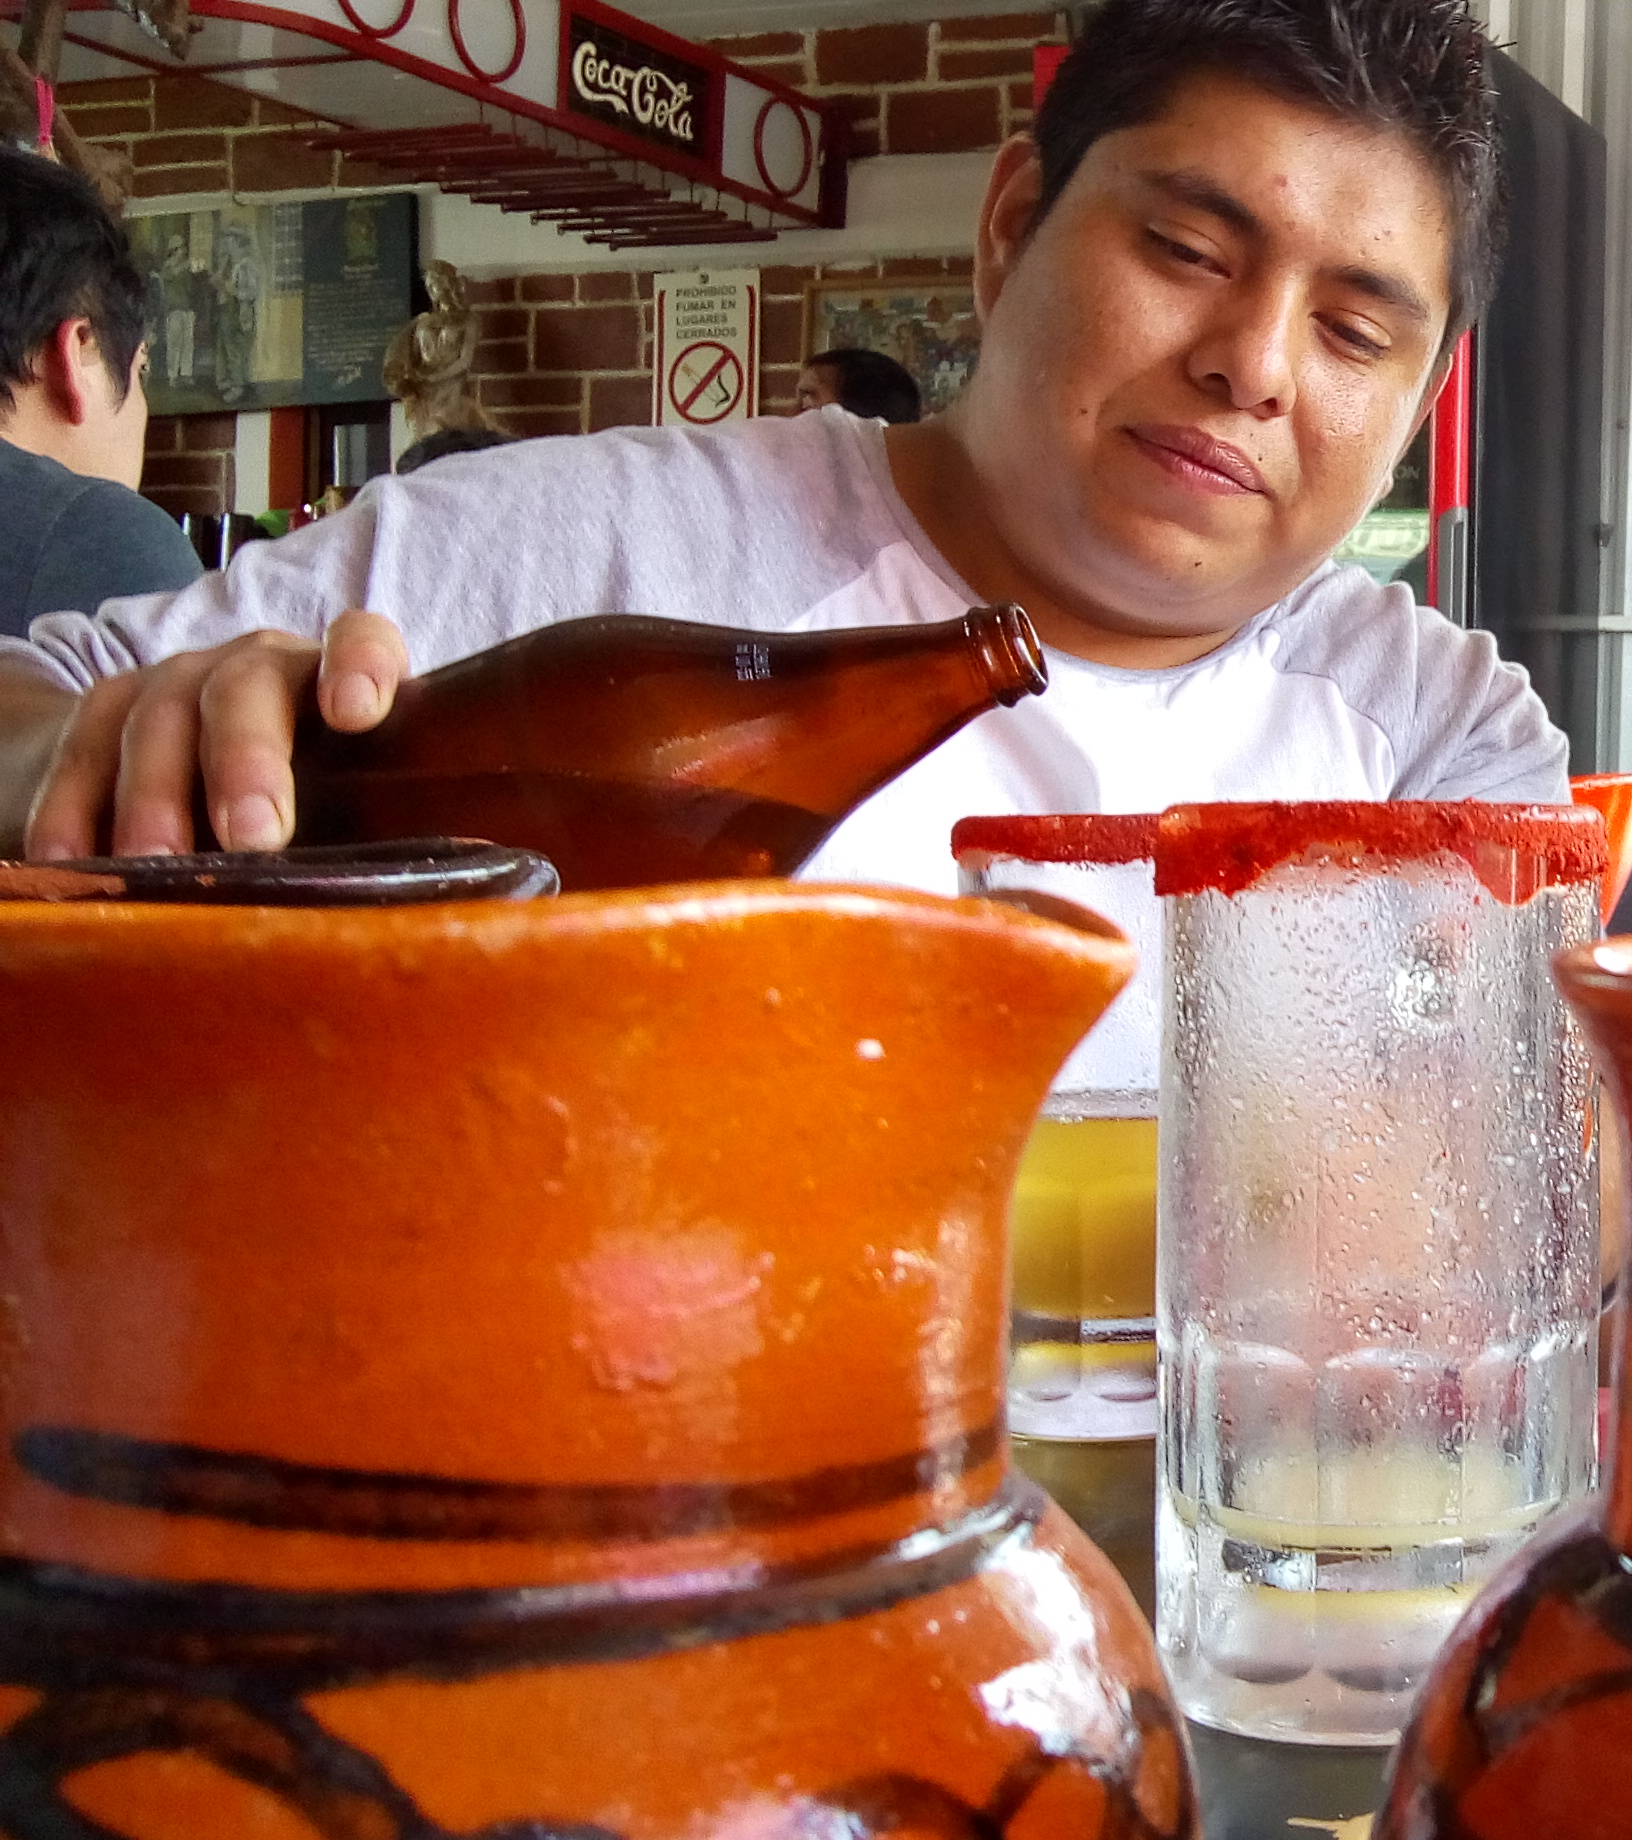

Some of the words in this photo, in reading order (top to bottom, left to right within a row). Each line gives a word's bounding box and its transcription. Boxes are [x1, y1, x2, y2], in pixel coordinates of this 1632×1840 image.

[676, 285, 737, 297] PROHIBIDO
[676, 299, 715, 311] FUMAR
[721, 298, 736, 310] EN
[676, 312, 728, 325] LUGARES
[676, 326, 738, 339] CERRADOS
